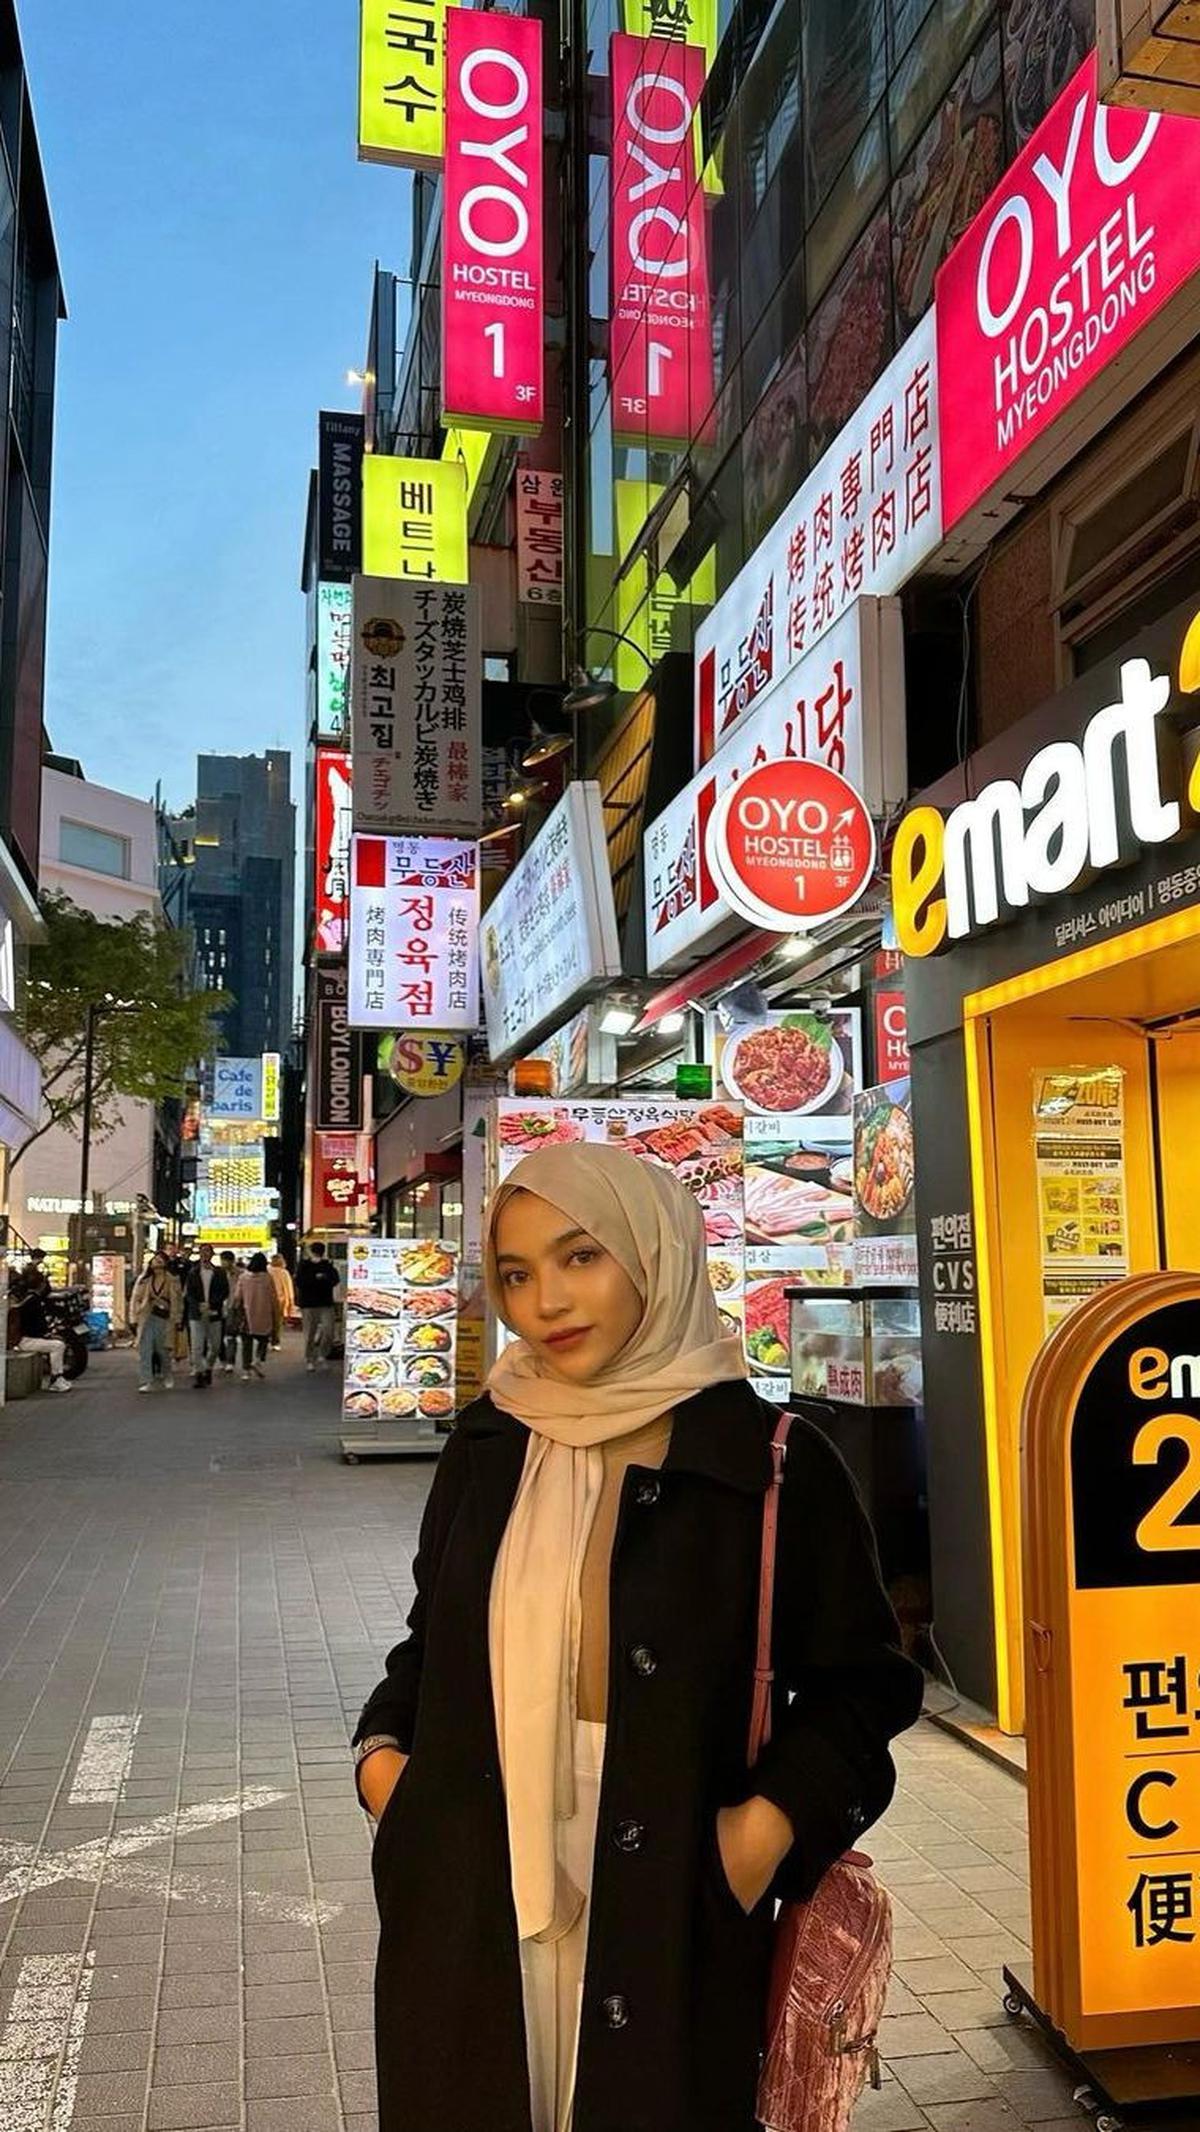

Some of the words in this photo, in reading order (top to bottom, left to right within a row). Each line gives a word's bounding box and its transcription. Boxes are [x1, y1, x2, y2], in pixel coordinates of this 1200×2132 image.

[384, 0, 438, 122] 국수
[459, 48, 529, 258] OYO
[977, 91, 1161, 338] OYO
[453, 263, 536, 292] HOSTEL
[454, 290, 535, 310] MYEONGDONG
[994, 193, 1155, 411] HOSTEL
[484, 322, 505, 378] 1
[997, 251, 1156, 451] MYEONGDONG
[515, 385, 537, 402] 3F
[332, 442, 352, 552] MASSAGE
[369, 665, 396, 749] 최고집
[413, 589, 440, 812] チーズタッカルビ炭焼き
[738, 796, 829, 834] OYO
[891, 658, 1181, 958] emart
[744, 835, 828, 859] HOSTEL
[745, 855, 828, 870] MYEONGDONG
[390, 850, 474, 887] 무등산
[834, 875, 849, 888] 3F
[793, 875, 806, 901] 1
[1055, 912, 1098, 948] 딜리셔스
[1098, 890, 1145, 928] 아이디어
[397, 895, 439, 1016] 정육점
[218, 1068, 253, 1083] Cafe
[235, 1085, 253, 1097] de
[210, 1099, 253, 1113] paris
[749, 1120, 781, 1135] 갈비
[931, 1212, 973, 1251] 편의점
[932, 1259, 974, 1291] CVS
[934, 1301, 976, 1334] 便利店
[755, 1380, 788, 1397] 갈비
[1122, 1656, 1200, 1740] 편
[1126, 1770, 1181, 1841] C
